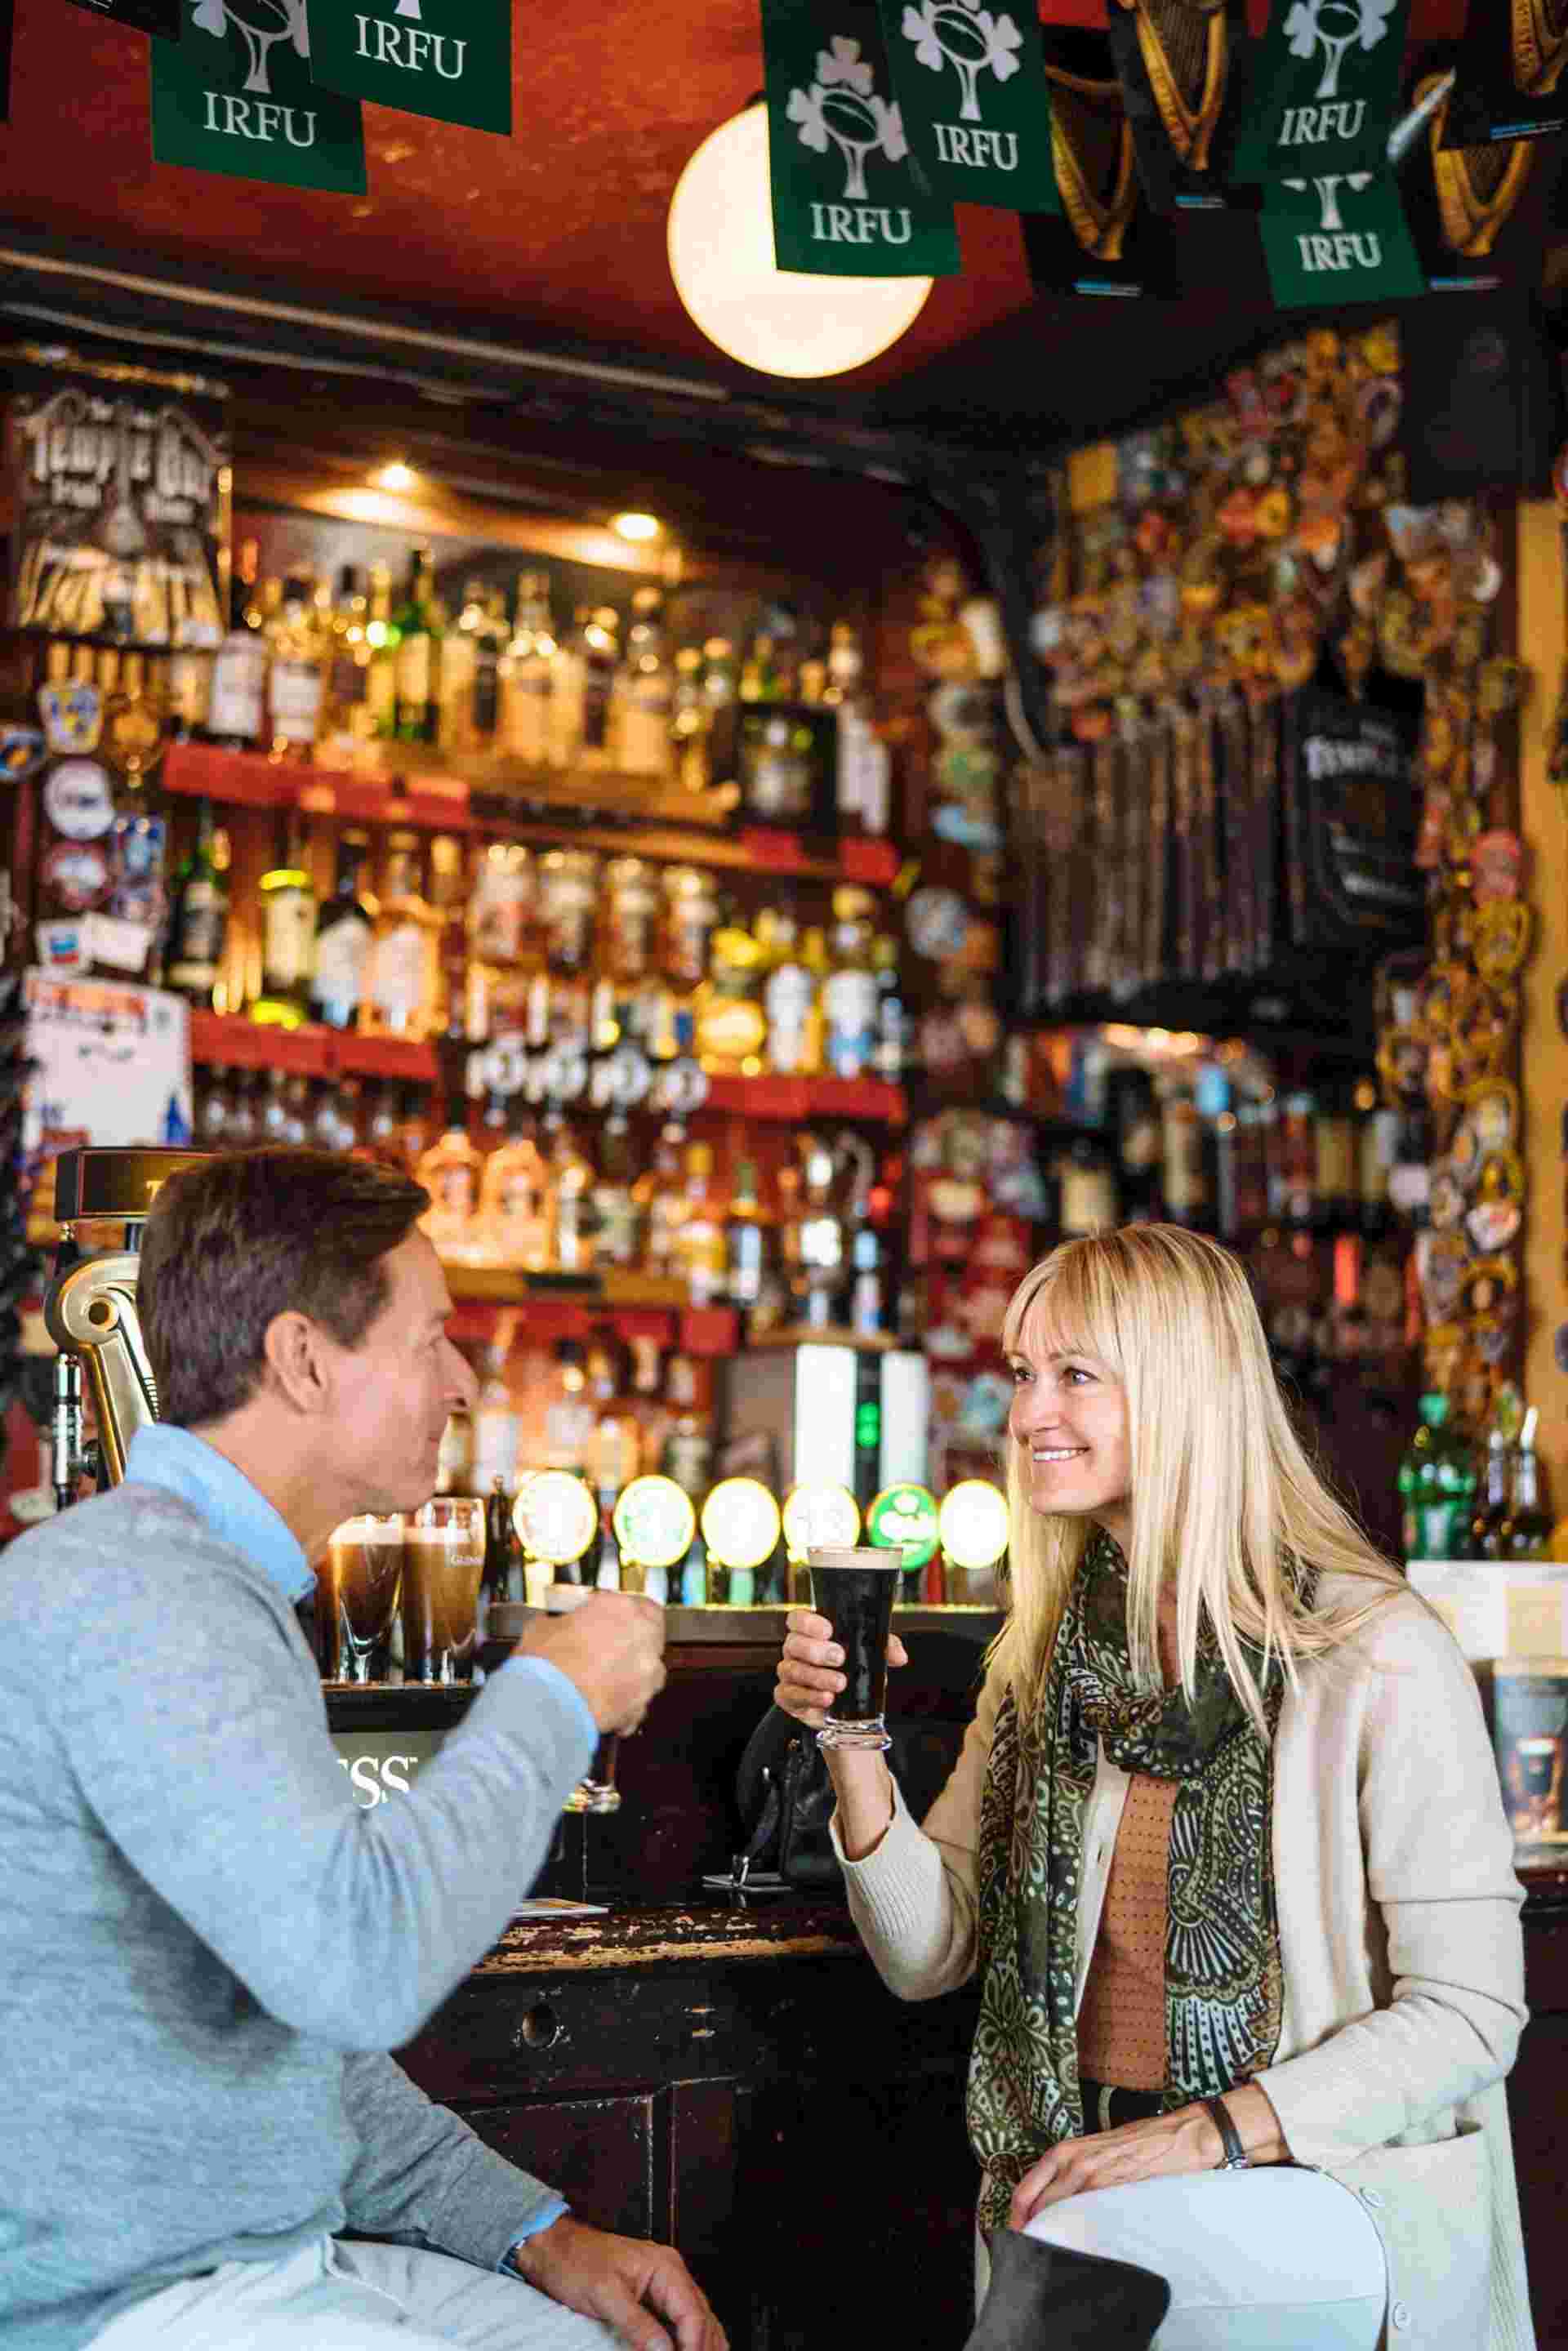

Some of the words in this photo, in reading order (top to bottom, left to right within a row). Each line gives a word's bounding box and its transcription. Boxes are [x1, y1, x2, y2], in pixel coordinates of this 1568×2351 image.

[354, 14, 468, 79] IRFU
[203, 91, 317, 148] IRFU
[1278, 100, 1366, 147] IRFU
[933, 123, 1019, 171] IRFU
[810, 203, 911, 244] IRFU
[1298, 233, 1383, 272] IRFU
